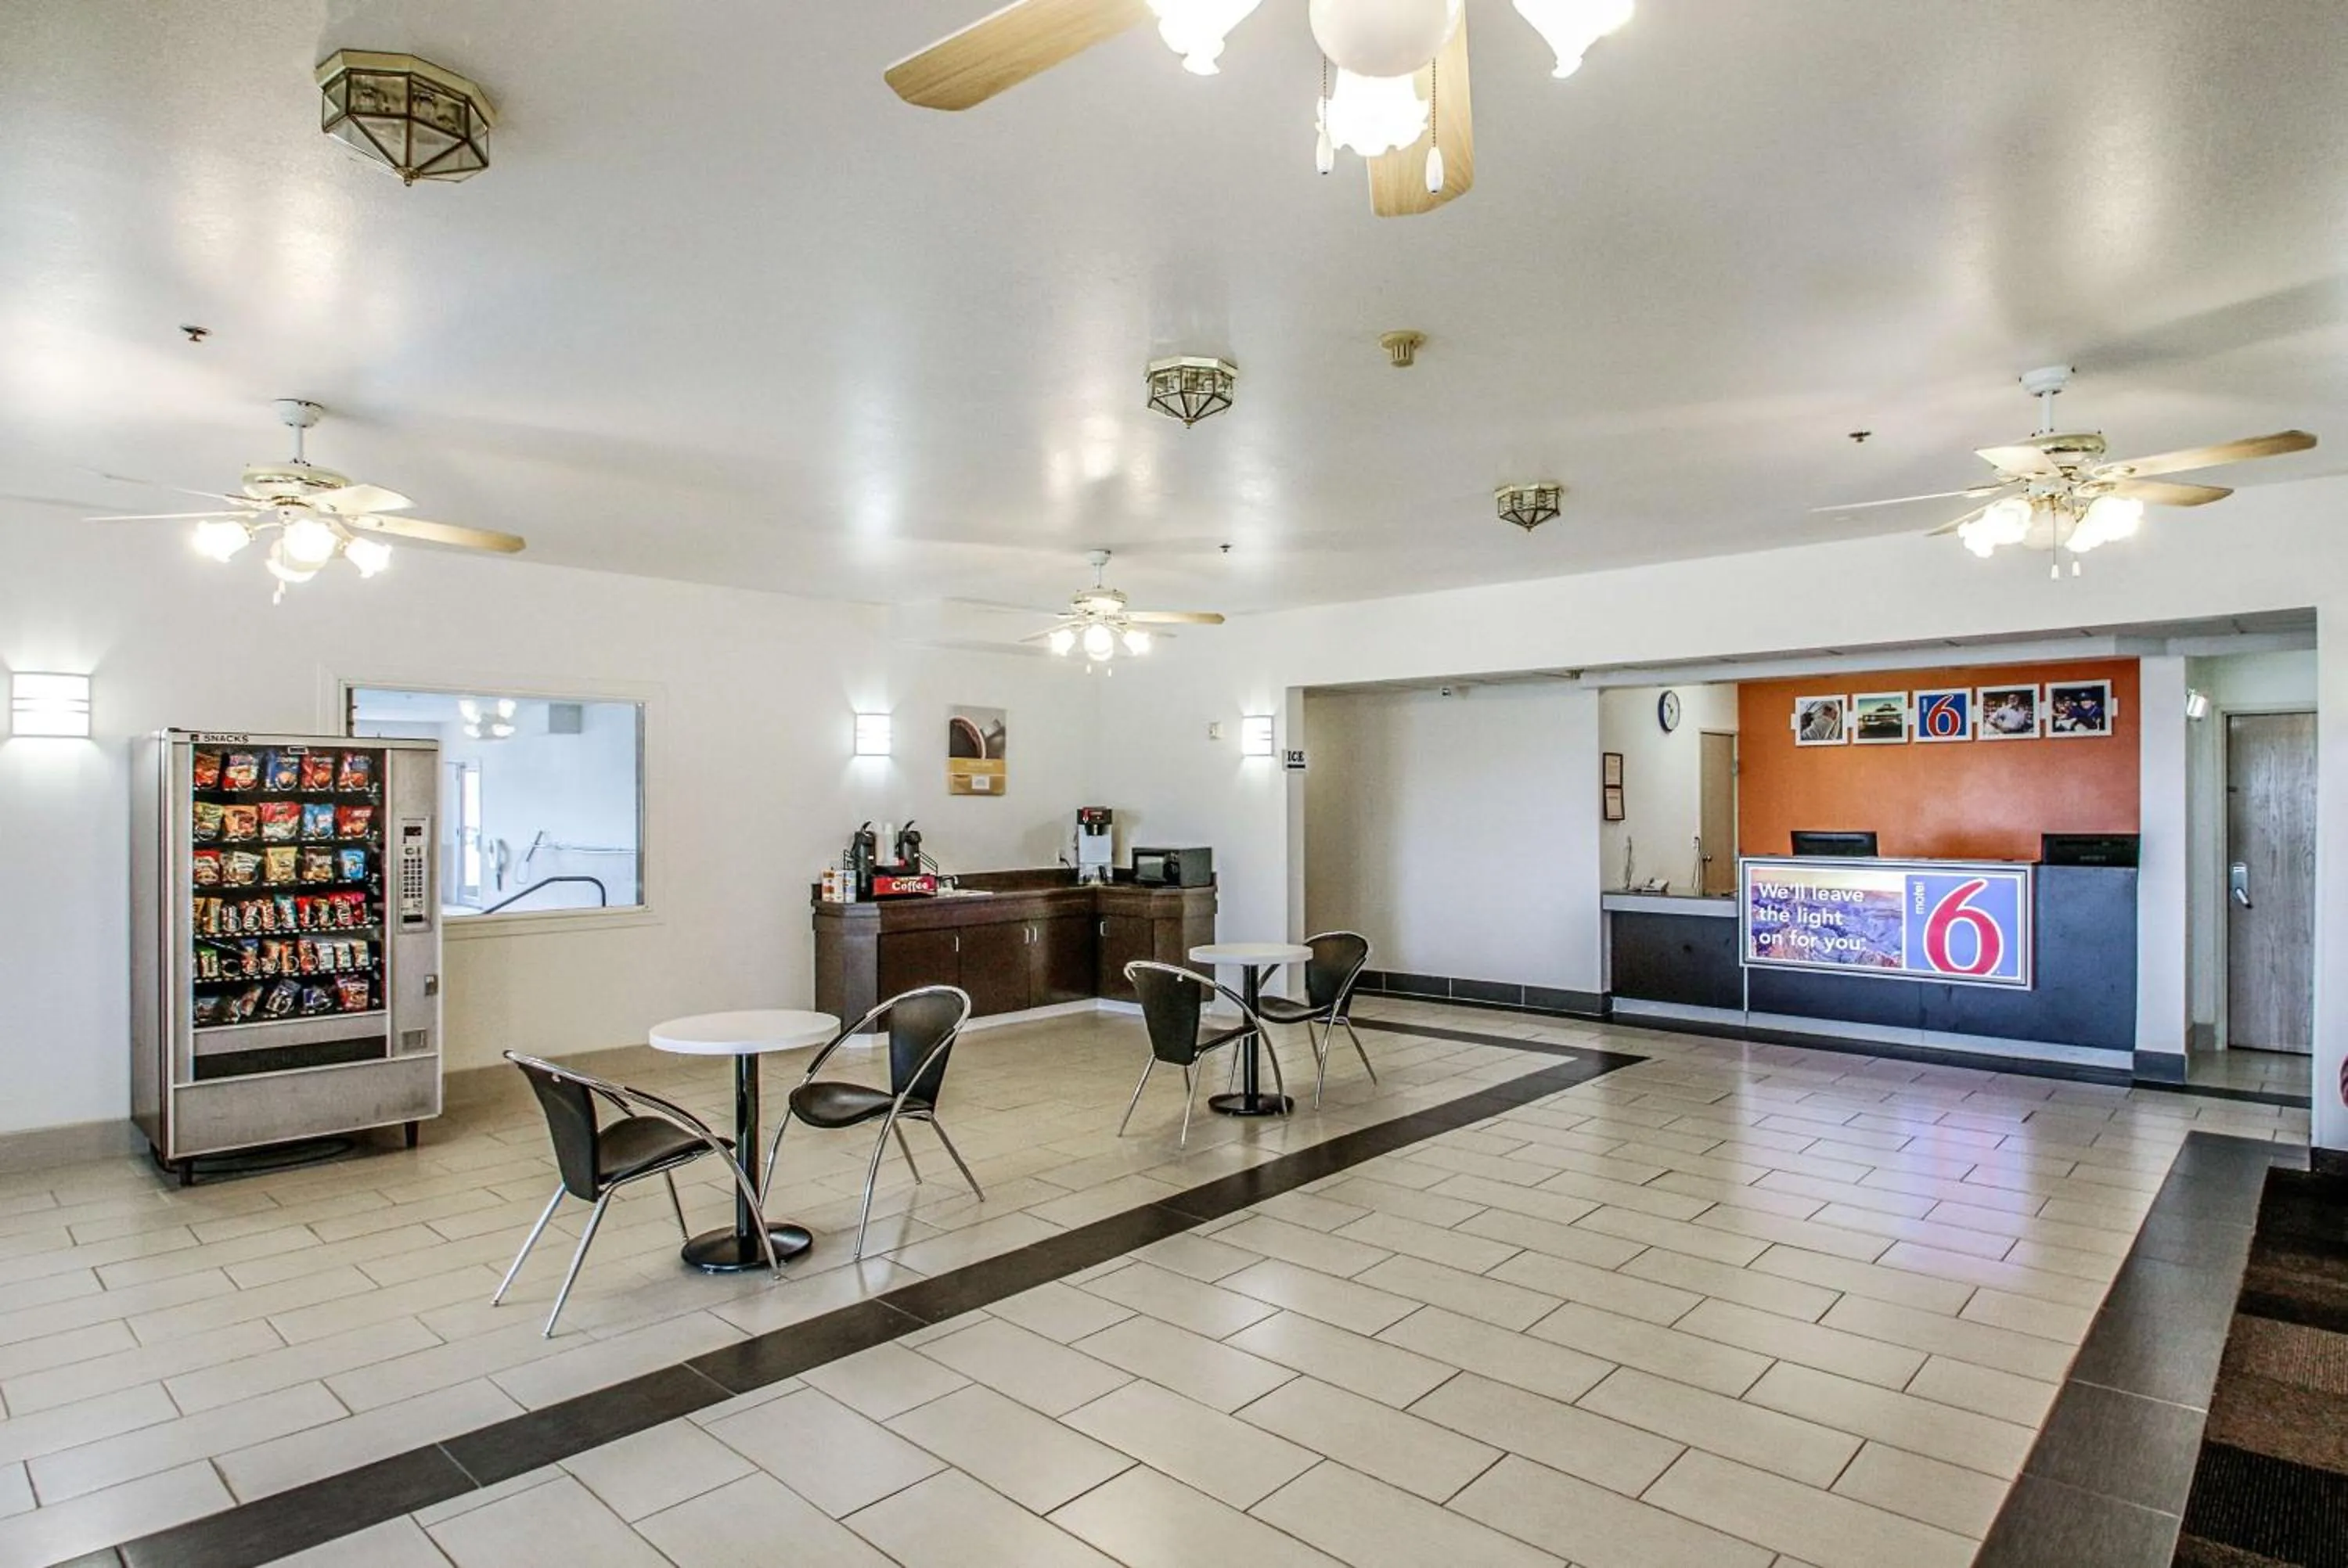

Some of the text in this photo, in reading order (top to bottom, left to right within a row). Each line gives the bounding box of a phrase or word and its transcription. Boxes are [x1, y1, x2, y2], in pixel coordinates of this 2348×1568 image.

[1926, 694, 1961, 737] 6
[203, 734, 250, 743] SNACKS
[1287, 750, 1305, 762] ICE
[891, 879, 929, 892] Coffee
[1759, 882, 1864, 902] We'll leave
[1913, 881, 1925, 915] motel
[1760, 904, 1843, 929] the light
[1923, 878, 2004, 977] 6
[1759, 932, 1783, 945] on
[1789, 929, 1818, 948] for
